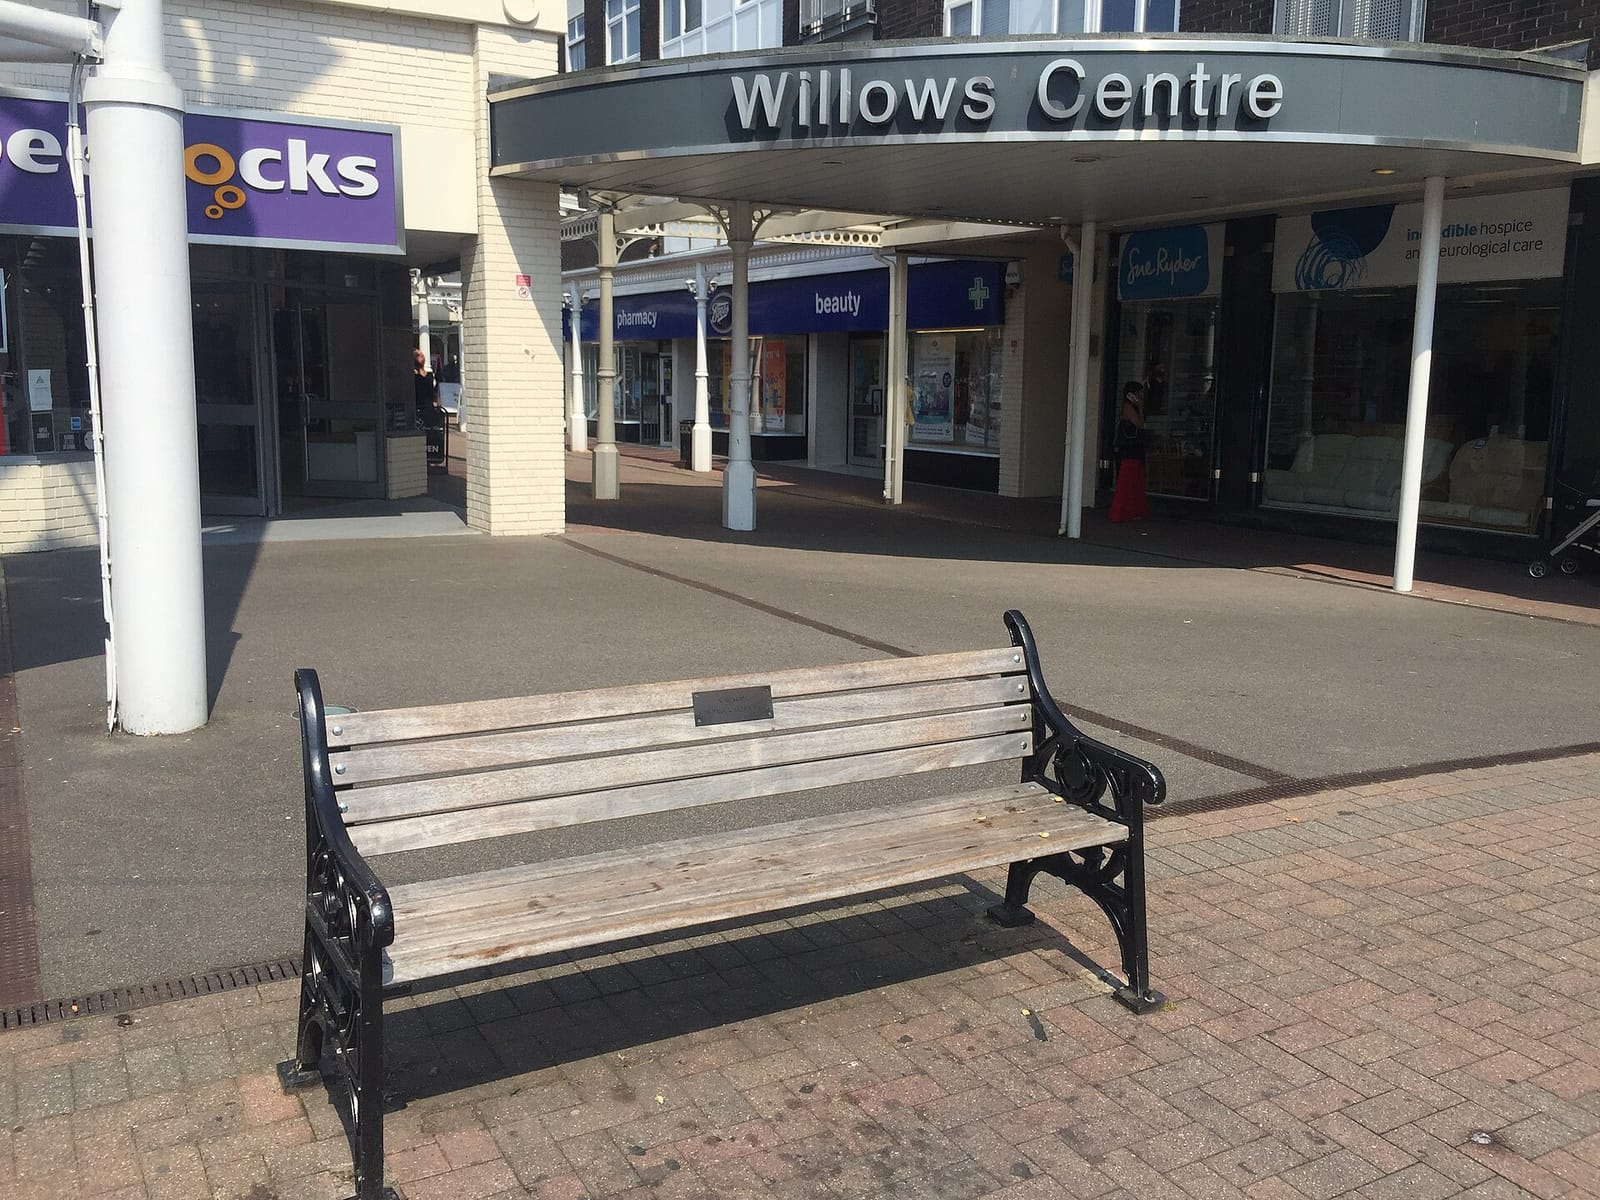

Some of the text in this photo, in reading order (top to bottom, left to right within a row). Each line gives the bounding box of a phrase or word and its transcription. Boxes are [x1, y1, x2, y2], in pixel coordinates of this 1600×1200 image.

[731, 58, 1284, 130] Willows Centre
[1480, 218, 1533, 237] hospice
[1405, 238, 1543, 260] an eurological care
[1127, 248, 1202, 285] Sue Ryder
[815, 291, 861, 317] beauty
[616, 309, 658, 330] pharmacy
